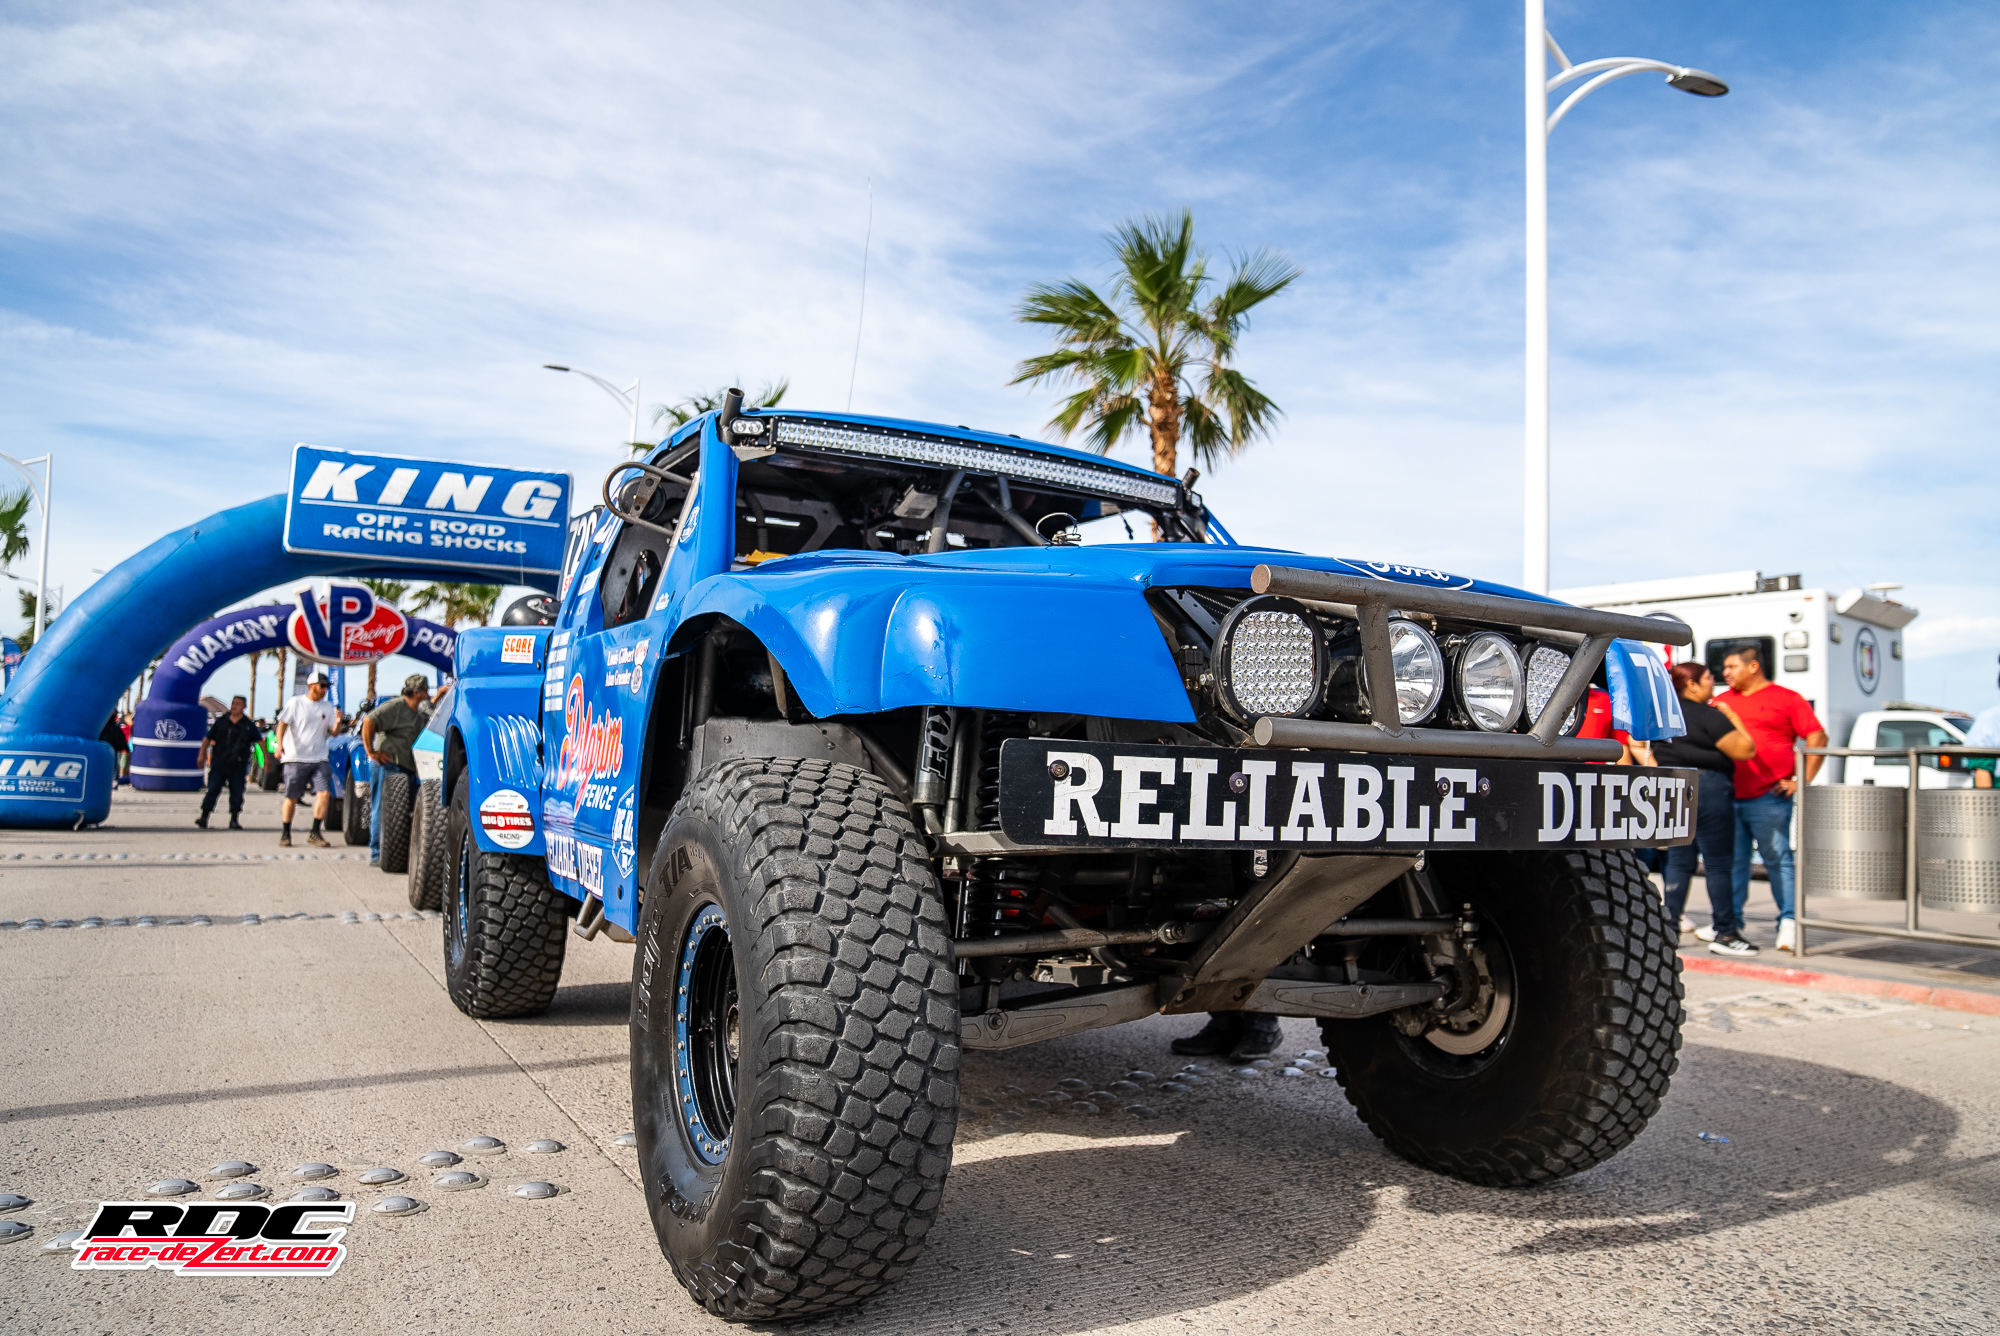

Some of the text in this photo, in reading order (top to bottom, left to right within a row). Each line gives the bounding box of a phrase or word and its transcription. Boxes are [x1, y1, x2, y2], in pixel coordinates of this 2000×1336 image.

[300, 460, 563, 520] KING
[356, 512, 408, 529] OFF
[430, 519, 506, 536] ROAD
[323, 524, 527, 554] RACING SHOCKS
[298, 583, 374, 660] VP
[346, 621, 404, 650] Racing
[345, 649, 384, 660] FUELS
[505, 638, 533, 653] SCORE
[0, 758, 82, 779] ING
[582, 783, 617, 811] FENCE
[1044, 751, 1690, 842] RELIABLE DIESEL
[481, 815, 497, 825] BIG
[505, 816, 532, 826] TIRES
[499, 833, 521, 841] RACING
[577, 840, 604, 898] DIESEL
